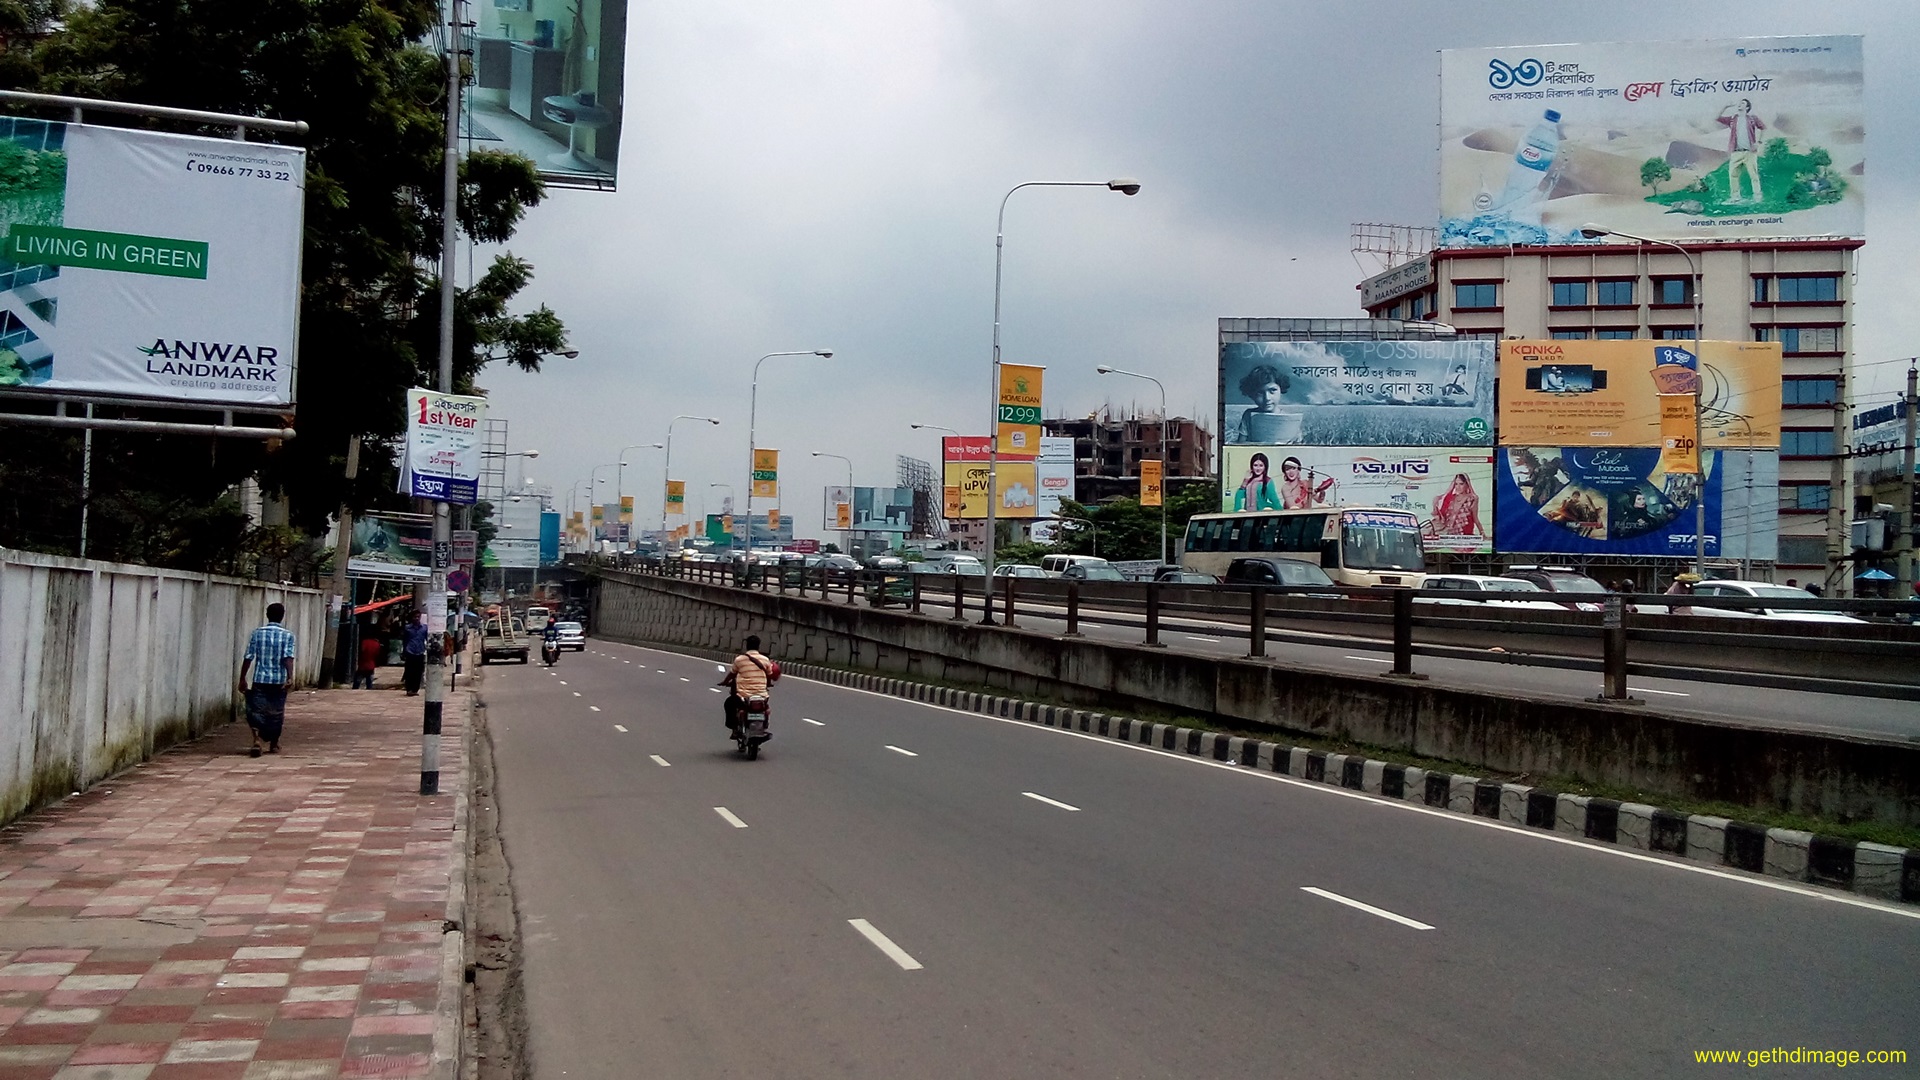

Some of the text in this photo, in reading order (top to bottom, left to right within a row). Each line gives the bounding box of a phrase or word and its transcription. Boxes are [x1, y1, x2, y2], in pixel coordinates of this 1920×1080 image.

[1545, 72, 1595, 84] পরিশোধিত
[1489, 92, 1512, 101] দেশের
[1546, 88, 1575, 98] নিরাপদ
[1577, 87, 1595, 97] পানি
[1598, 88, 1618, 99] সুপার
[187, 152, 289, 167] www.anwarlandmark.com
[1522, 148, 1540, 159] Fresh
[197, 164, 290, 181] 09666 77 33 22
[15, 235, 201, 269] LIVING IN GREEN
[1375, 275, 1428, 301] MAANCO HOUSE
[147, 338, 278, 366] ANWAR
[1511, 345, 1564, 354] KONKA
[146, 360, 277, 382] LANDMARK
[1292, 366, 1338, 378] ফসলের
[1342, 362, 1370, 378] মাঠে
[170, 379, 277, 393] creating addresses
[1342, 383, 1375, 396] স্বপ্নও
[1380, 383, 1411, 396] বোনা
[418, 396, 478, 429] 1st Year
[1468, 421, 1483, 429] ACI
[1675, 435, 1694, 455] zip
[1591, 450, 1622, 465] Eid
[964, 480, 990, 491] uPV
[1044, 479, 1067, 487] Bengal
[1668, 534, 1717, 544] STAR
